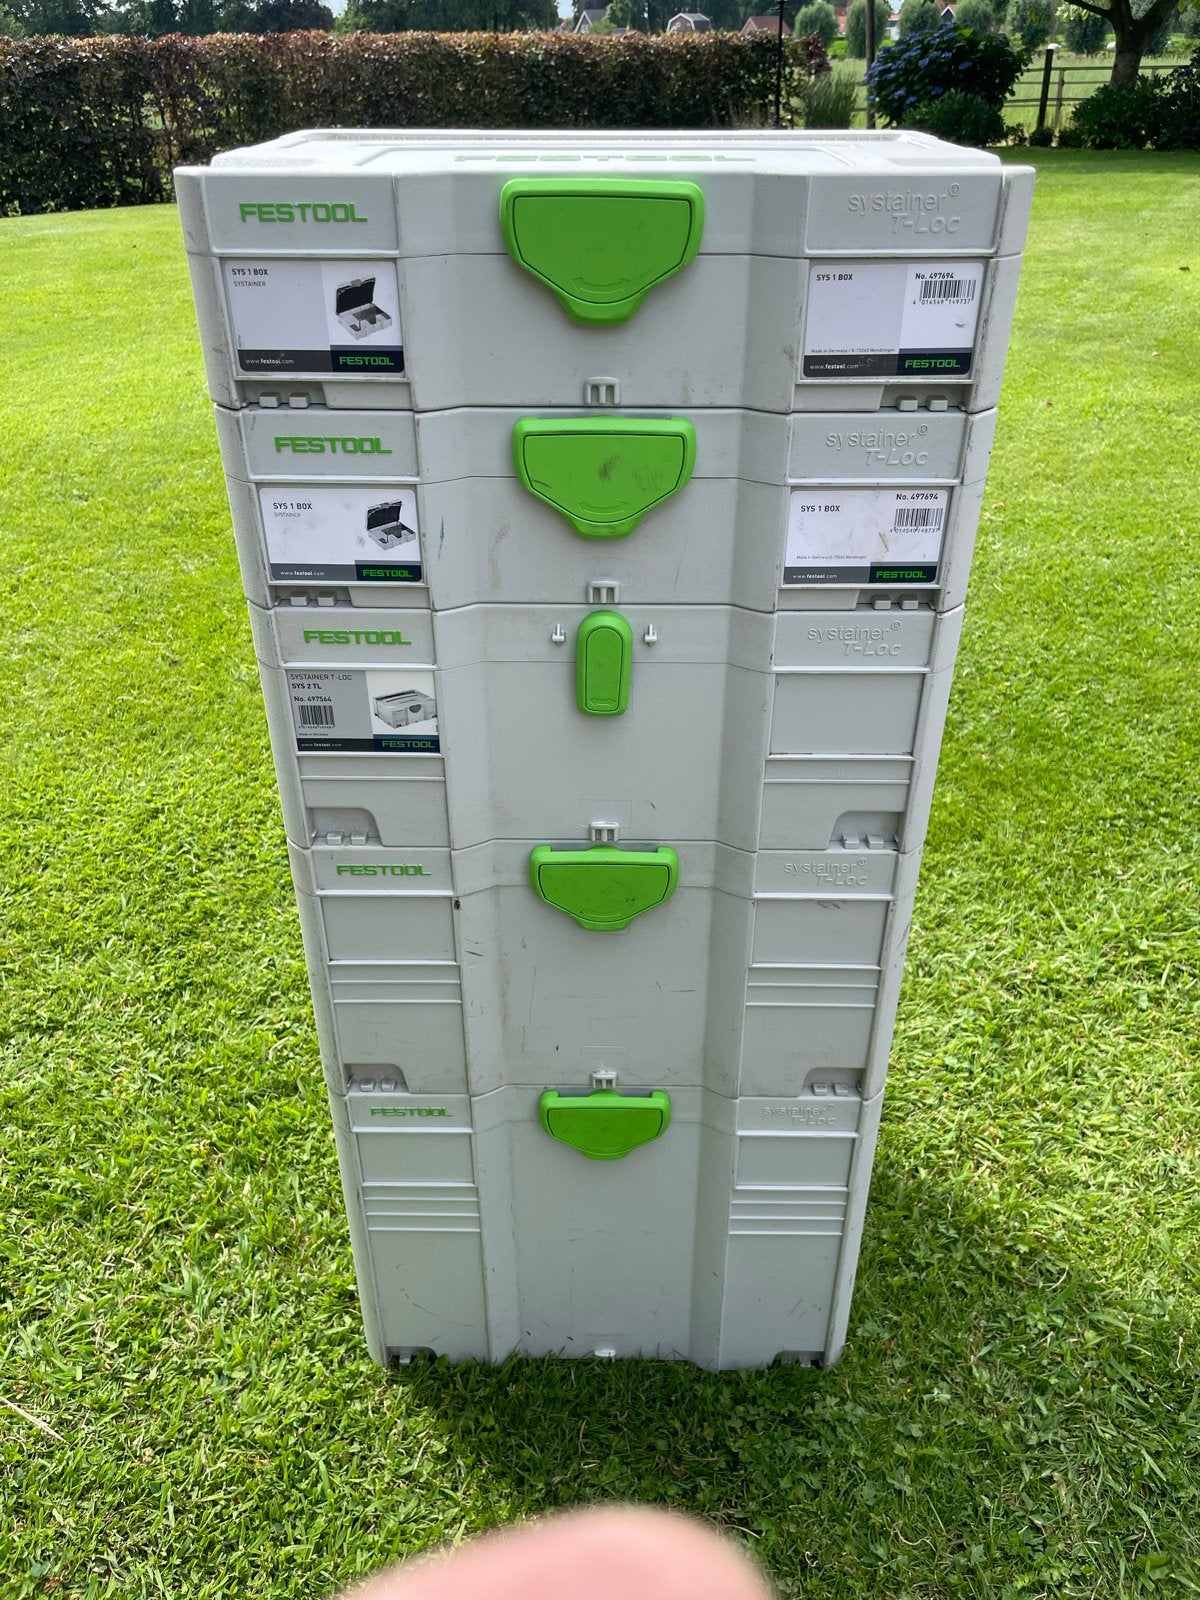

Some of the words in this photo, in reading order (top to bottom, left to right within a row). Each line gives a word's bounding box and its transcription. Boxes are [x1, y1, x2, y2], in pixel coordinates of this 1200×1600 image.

[239, 202, 368, 222] FESTOOL
[232, 268, 246, 276] SYS
[253, 268, 269, 276] BOX
[915, 272, 927, 280] No.
[929, 272, 954, 280] 497694
[838, 273, 853, 281] BOX
[339, 356, 395, 366] FESTOOL
[905, 359, 961, 369] FESTOOL
[274, 435, 393, 454] FESTOOL
[273, 502, 288, 510] SYS
[290, 502, 294, 510] 1
[296, 502, 313, 510] BOX
[362, 569, 413, 578] FESTOOL
[876, 571, 927, 579] FESTOOL
[303, 629, 412, 645] FESTOOL
[382, 740, 435, 748] FESTOOL
[336, 864, 432, 876] FESTOOL
[370, 1106, 454, 1117] FESTOOL
